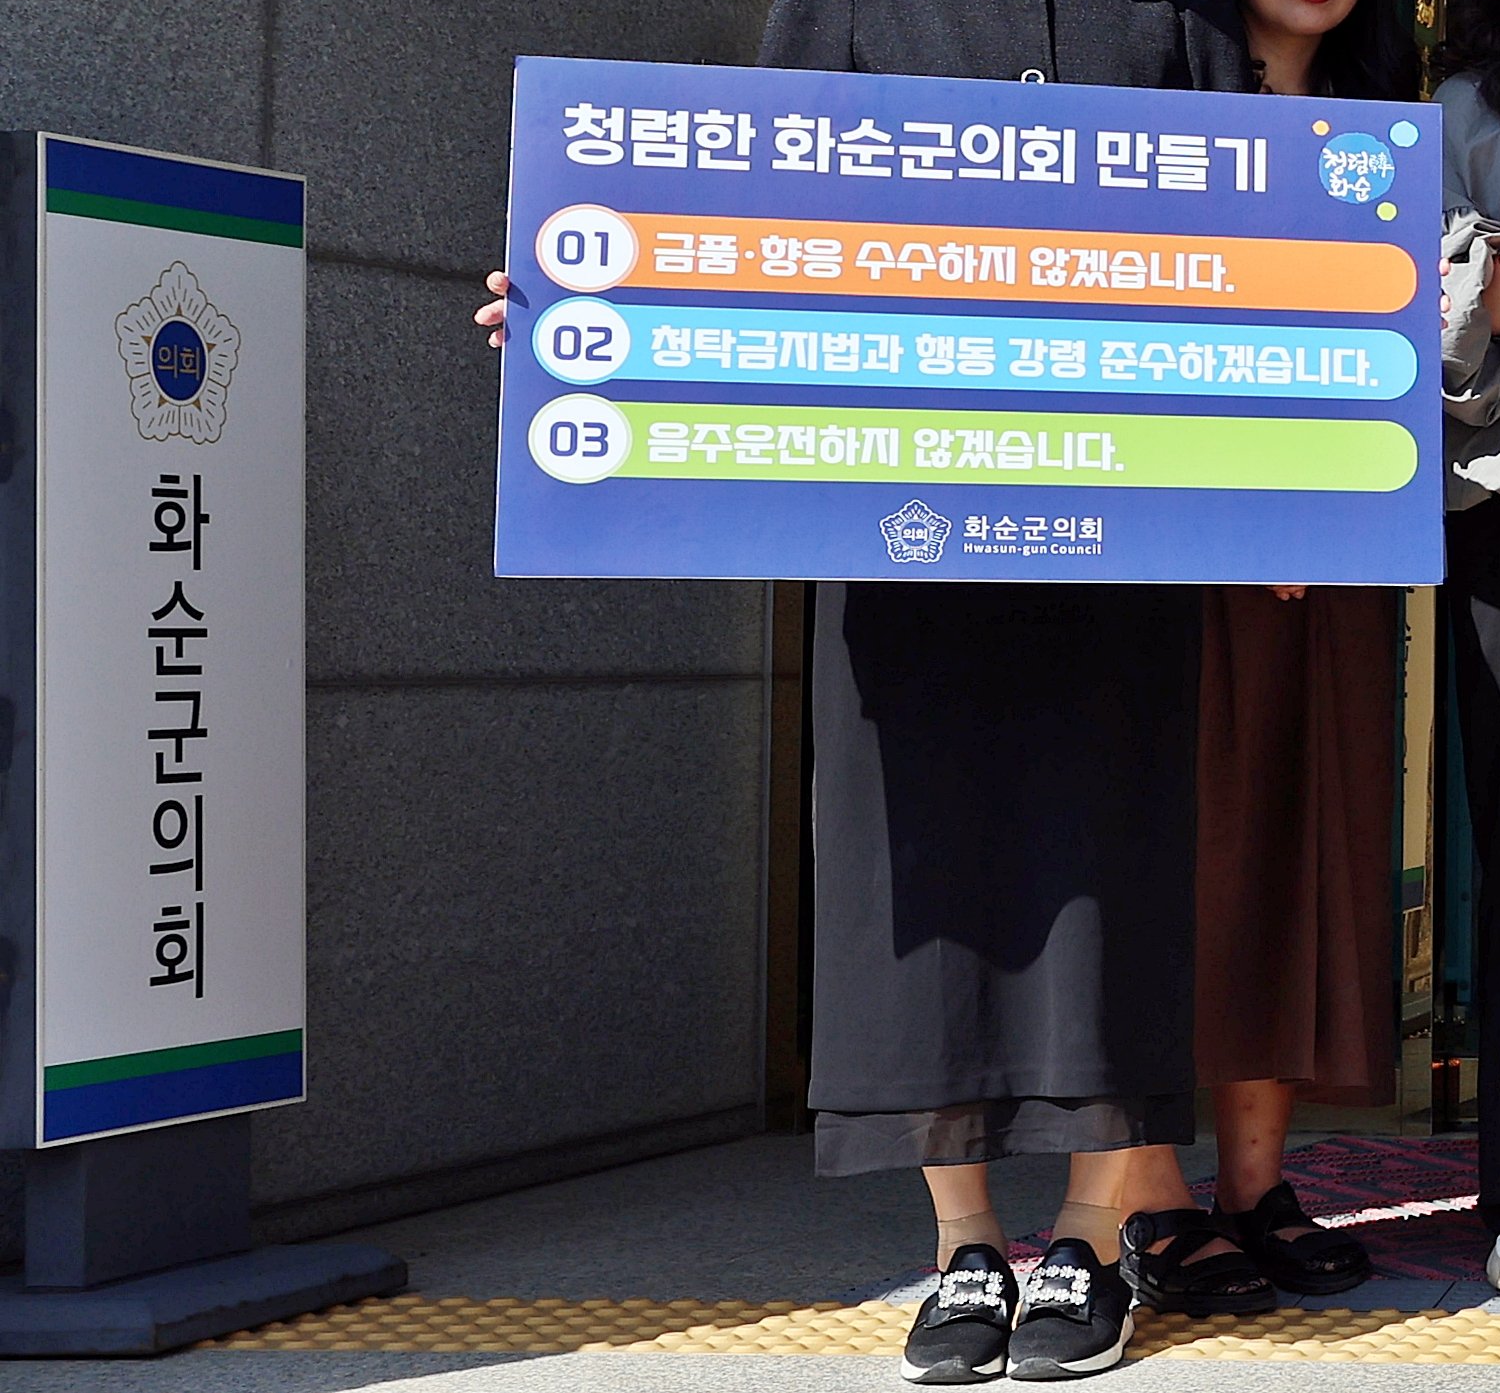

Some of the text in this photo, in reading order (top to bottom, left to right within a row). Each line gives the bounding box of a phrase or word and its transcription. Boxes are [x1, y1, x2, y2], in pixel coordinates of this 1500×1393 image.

[562, 104, 1268, 193] 청렴한 화순군의회 만들기
[1328, 172, 1371, 202] 화순
[556, 230, 610, 267] 01
[653, 232, 1236, 293] 금품·향응 수수하지 않겠습니다.
[552, 323, 613, 362] 02
[650, 324, 1380, 389] 청탁금지법과 행동 강령 준수하겠습니다.
[157, 344, 200, 381] 의회
[549, 419, 610, 458] 03
[647, 421, 1125, 473] 음주운전하지 않겠습니다.
[902, 527, 929, 542] 의회
[963, 515, 1103, 543] 화순군의회
[963, 542, 1102, 557] Hwasun-gun Council
[148, 473, 212, 1000] 화순군의회
